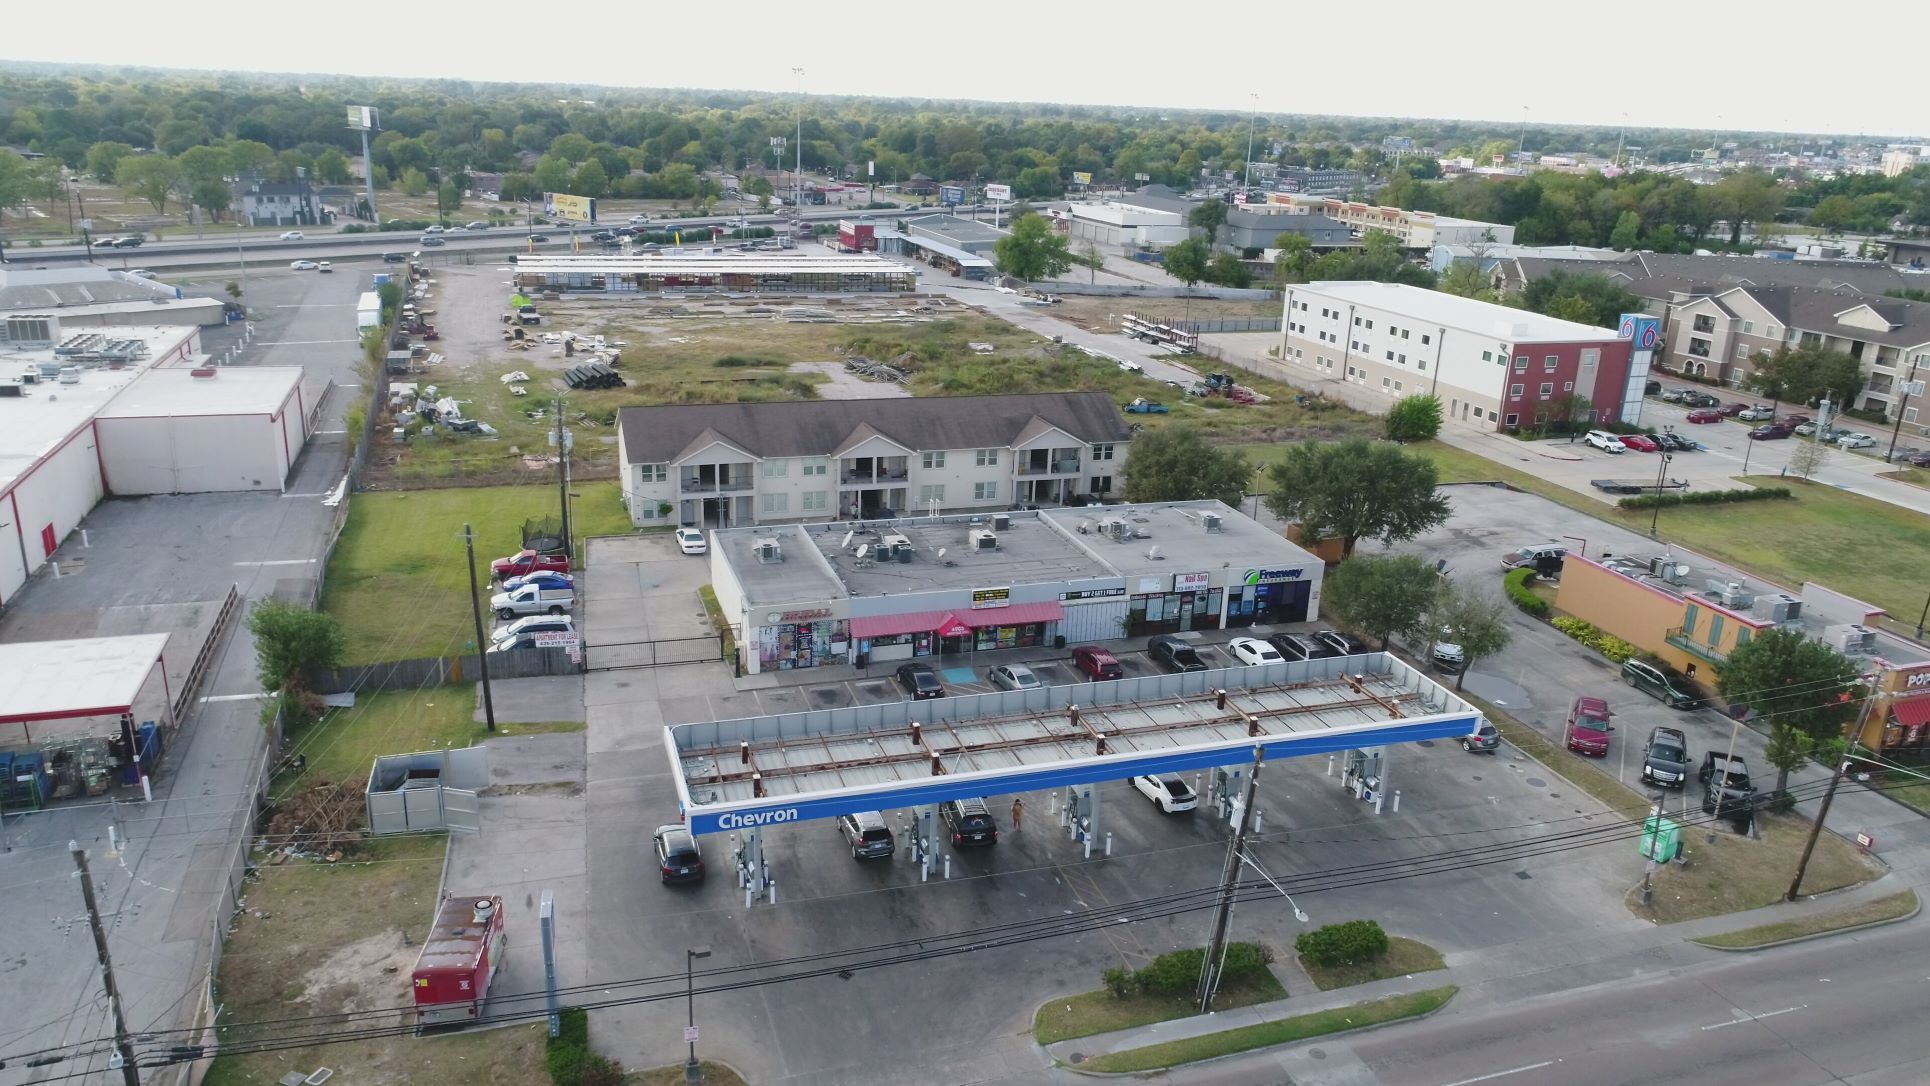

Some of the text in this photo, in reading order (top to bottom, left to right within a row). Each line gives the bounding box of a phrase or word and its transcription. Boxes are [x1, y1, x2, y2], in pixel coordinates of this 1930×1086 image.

[1622, 316, 1634, 337] 6
[1641, 322, 1656, 347] 6
[1184, 573, 1208, 583] Nail Spa
[1259, 569, 1304, 579] Freeway
[719, 808, 798, 829] Chevron
